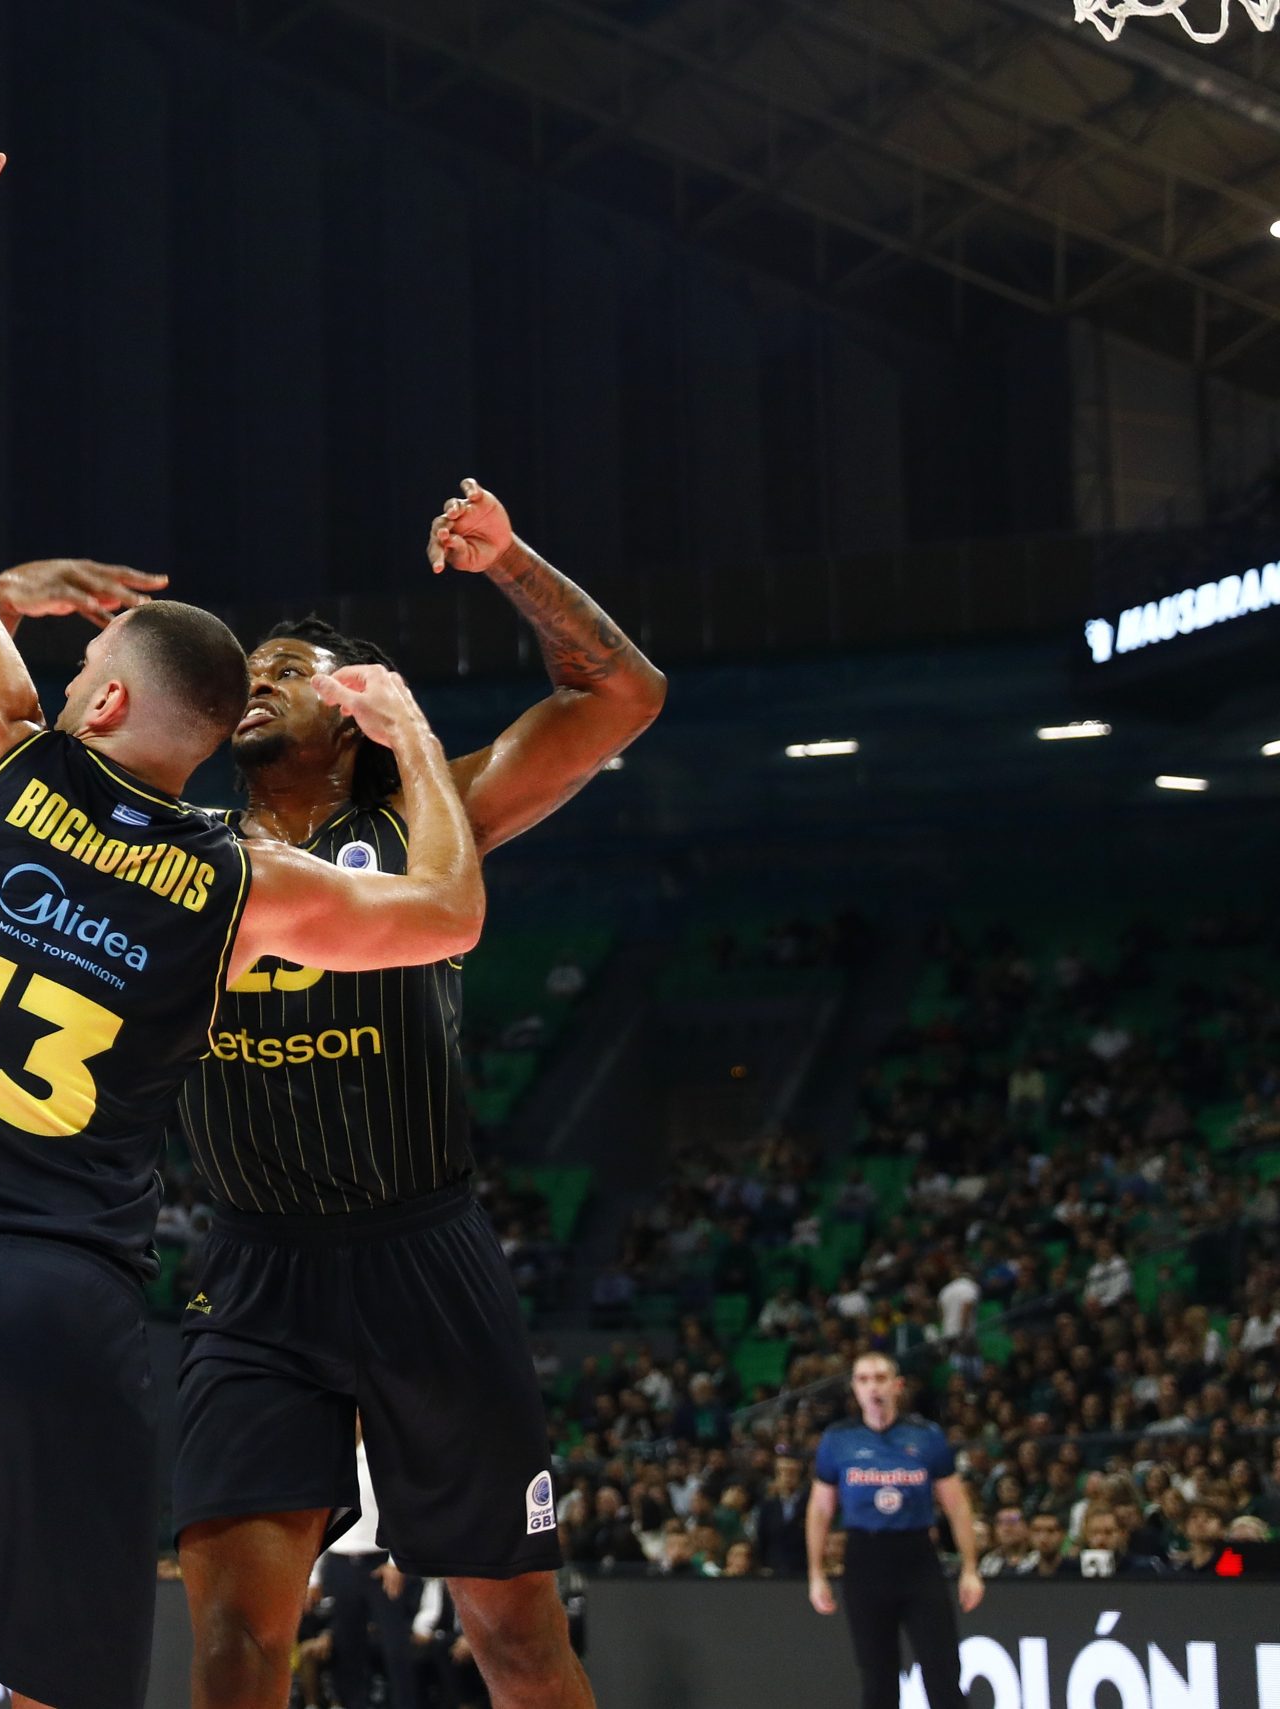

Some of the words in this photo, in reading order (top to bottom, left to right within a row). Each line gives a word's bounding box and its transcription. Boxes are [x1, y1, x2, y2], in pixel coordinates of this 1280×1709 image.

[4, 778, 215, 913] BOCHORIDIS
[12, 891, 148, 972] Midea
[42, 942, 126, 991] ΤΟΥΡΝΙΚΙΩΤΗ
[214, 1026, 381, 1068] etsson
[531, 1515, 556, 1529] GB
